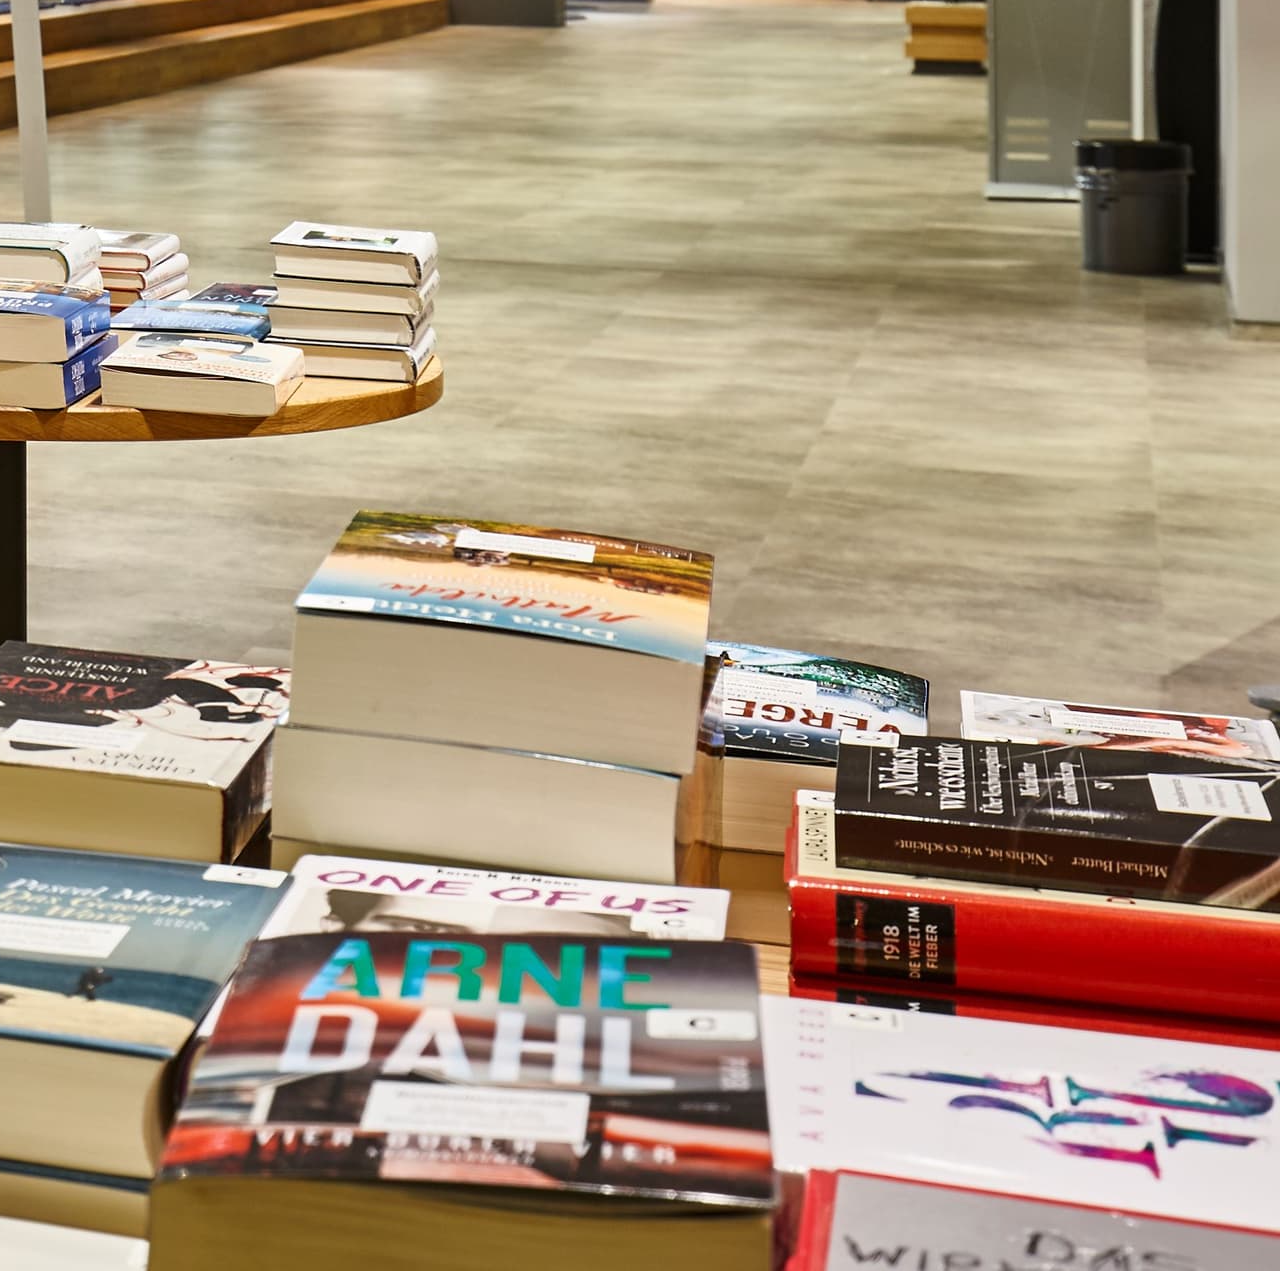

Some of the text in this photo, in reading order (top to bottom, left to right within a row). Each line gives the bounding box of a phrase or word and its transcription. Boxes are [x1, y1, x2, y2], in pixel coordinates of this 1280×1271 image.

[512, 614, 618, 641] Dora
[21, 654, 149, 675] WUNDERLAND
[24, 665, 129, 684] FINSTERNIS
[960, 843, 981, 857] wie
[1070, 855, 1114, 874] Butter
[1116, 860, 1170, 879] Michael
[6, 878, 234, 912] Pascal Mercier
[69, 892, 194, 919] Gewicht
[317, 868, 697, 917] ONE OF US
[883, 924, 901, 961] 1918
[907, 906, 922, 979] DIE WELT IM
[926, 924, 939, 970] FIEBER
[298, 938, 673, 1011] ARNE
[687, 1015, 716, 1030] C
[278, 1003, 676, 1091] DAHL
[799, 1084, 825, 1144] AVA
[255, 1126, 354, 1148] VIER
[571, 1139, 678, 1166] VIER
